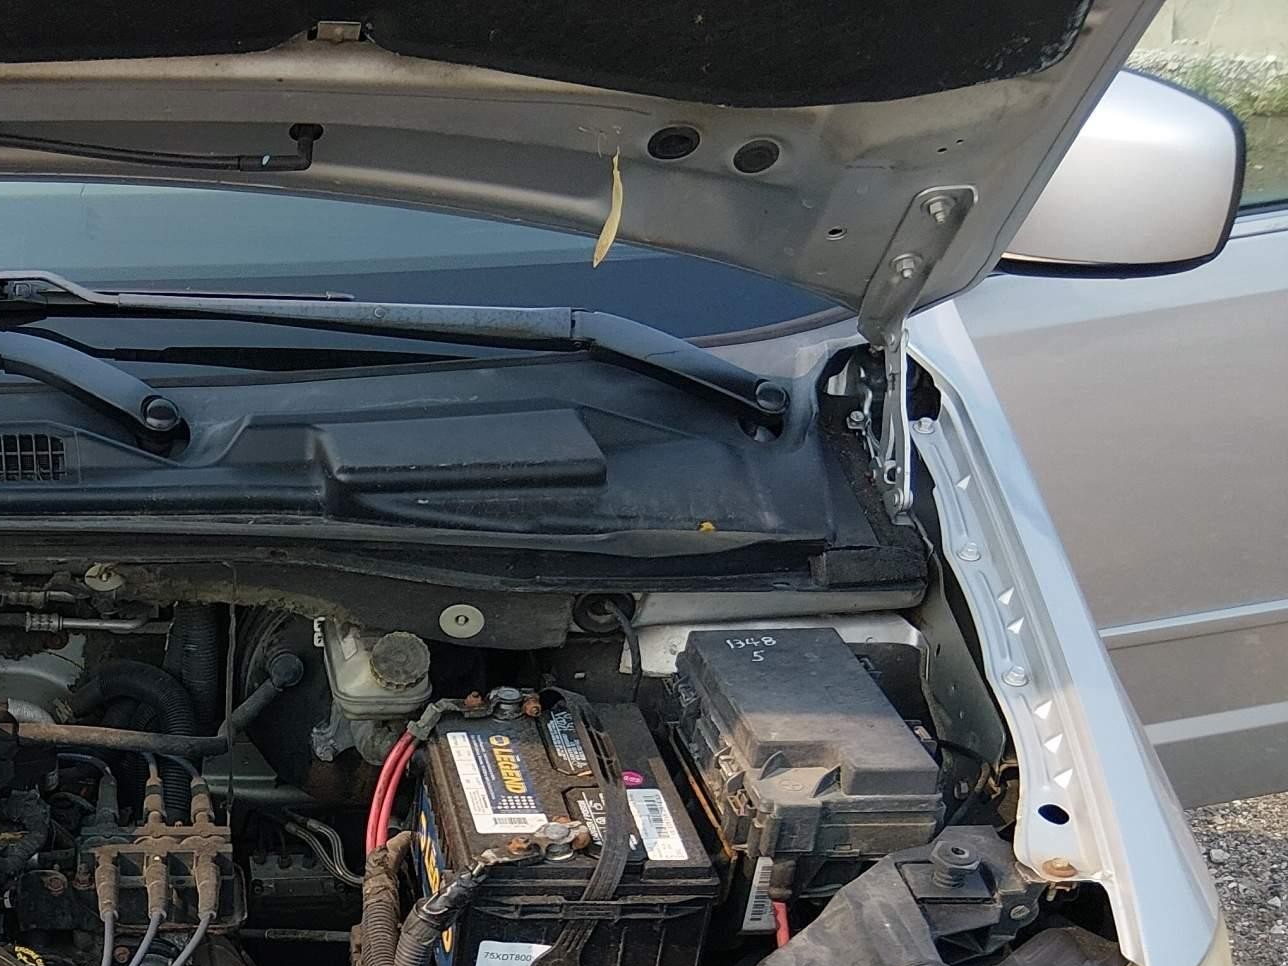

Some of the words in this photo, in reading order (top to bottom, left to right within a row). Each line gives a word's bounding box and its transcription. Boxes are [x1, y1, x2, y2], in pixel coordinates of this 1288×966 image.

[725, 636, 777, 648] 1348
[752, 650, 765, 662] 5
[491, 747, 528, 794] LEGEND
[483, 951, 532, 962] 75XDT800
